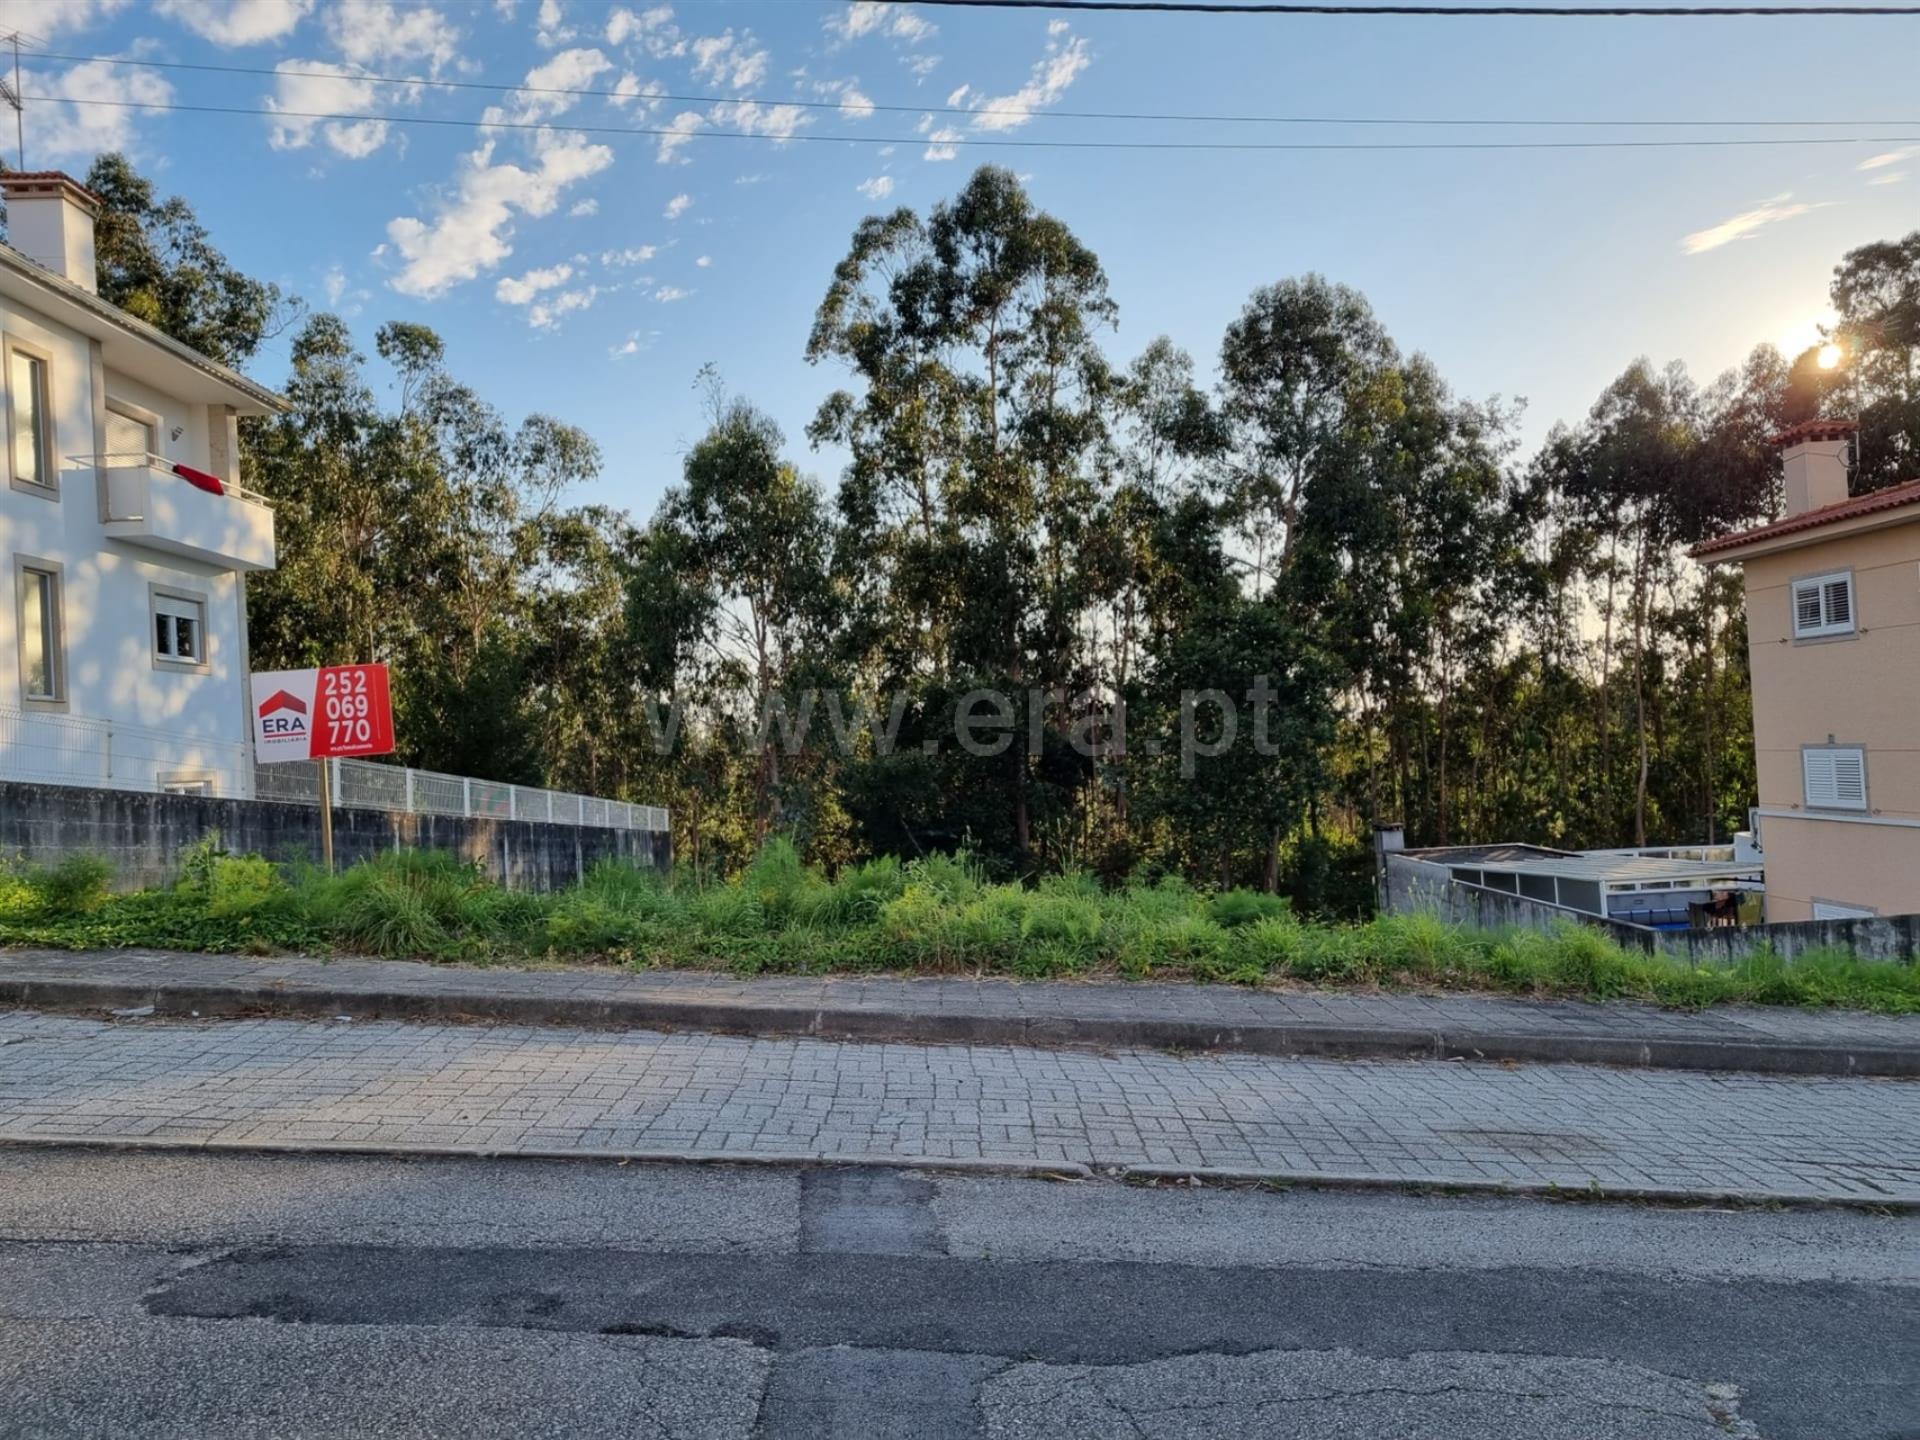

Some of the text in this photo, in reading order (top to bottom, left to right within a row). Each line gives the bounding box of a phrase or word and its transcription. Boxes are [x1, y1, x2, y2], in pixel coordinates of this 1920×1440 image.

[324, 670, 368, 695] 252
[326, 694, 369, 720] 069
[262, 717, 305, 733] ERA
[328, 719, 371, 744] 770
